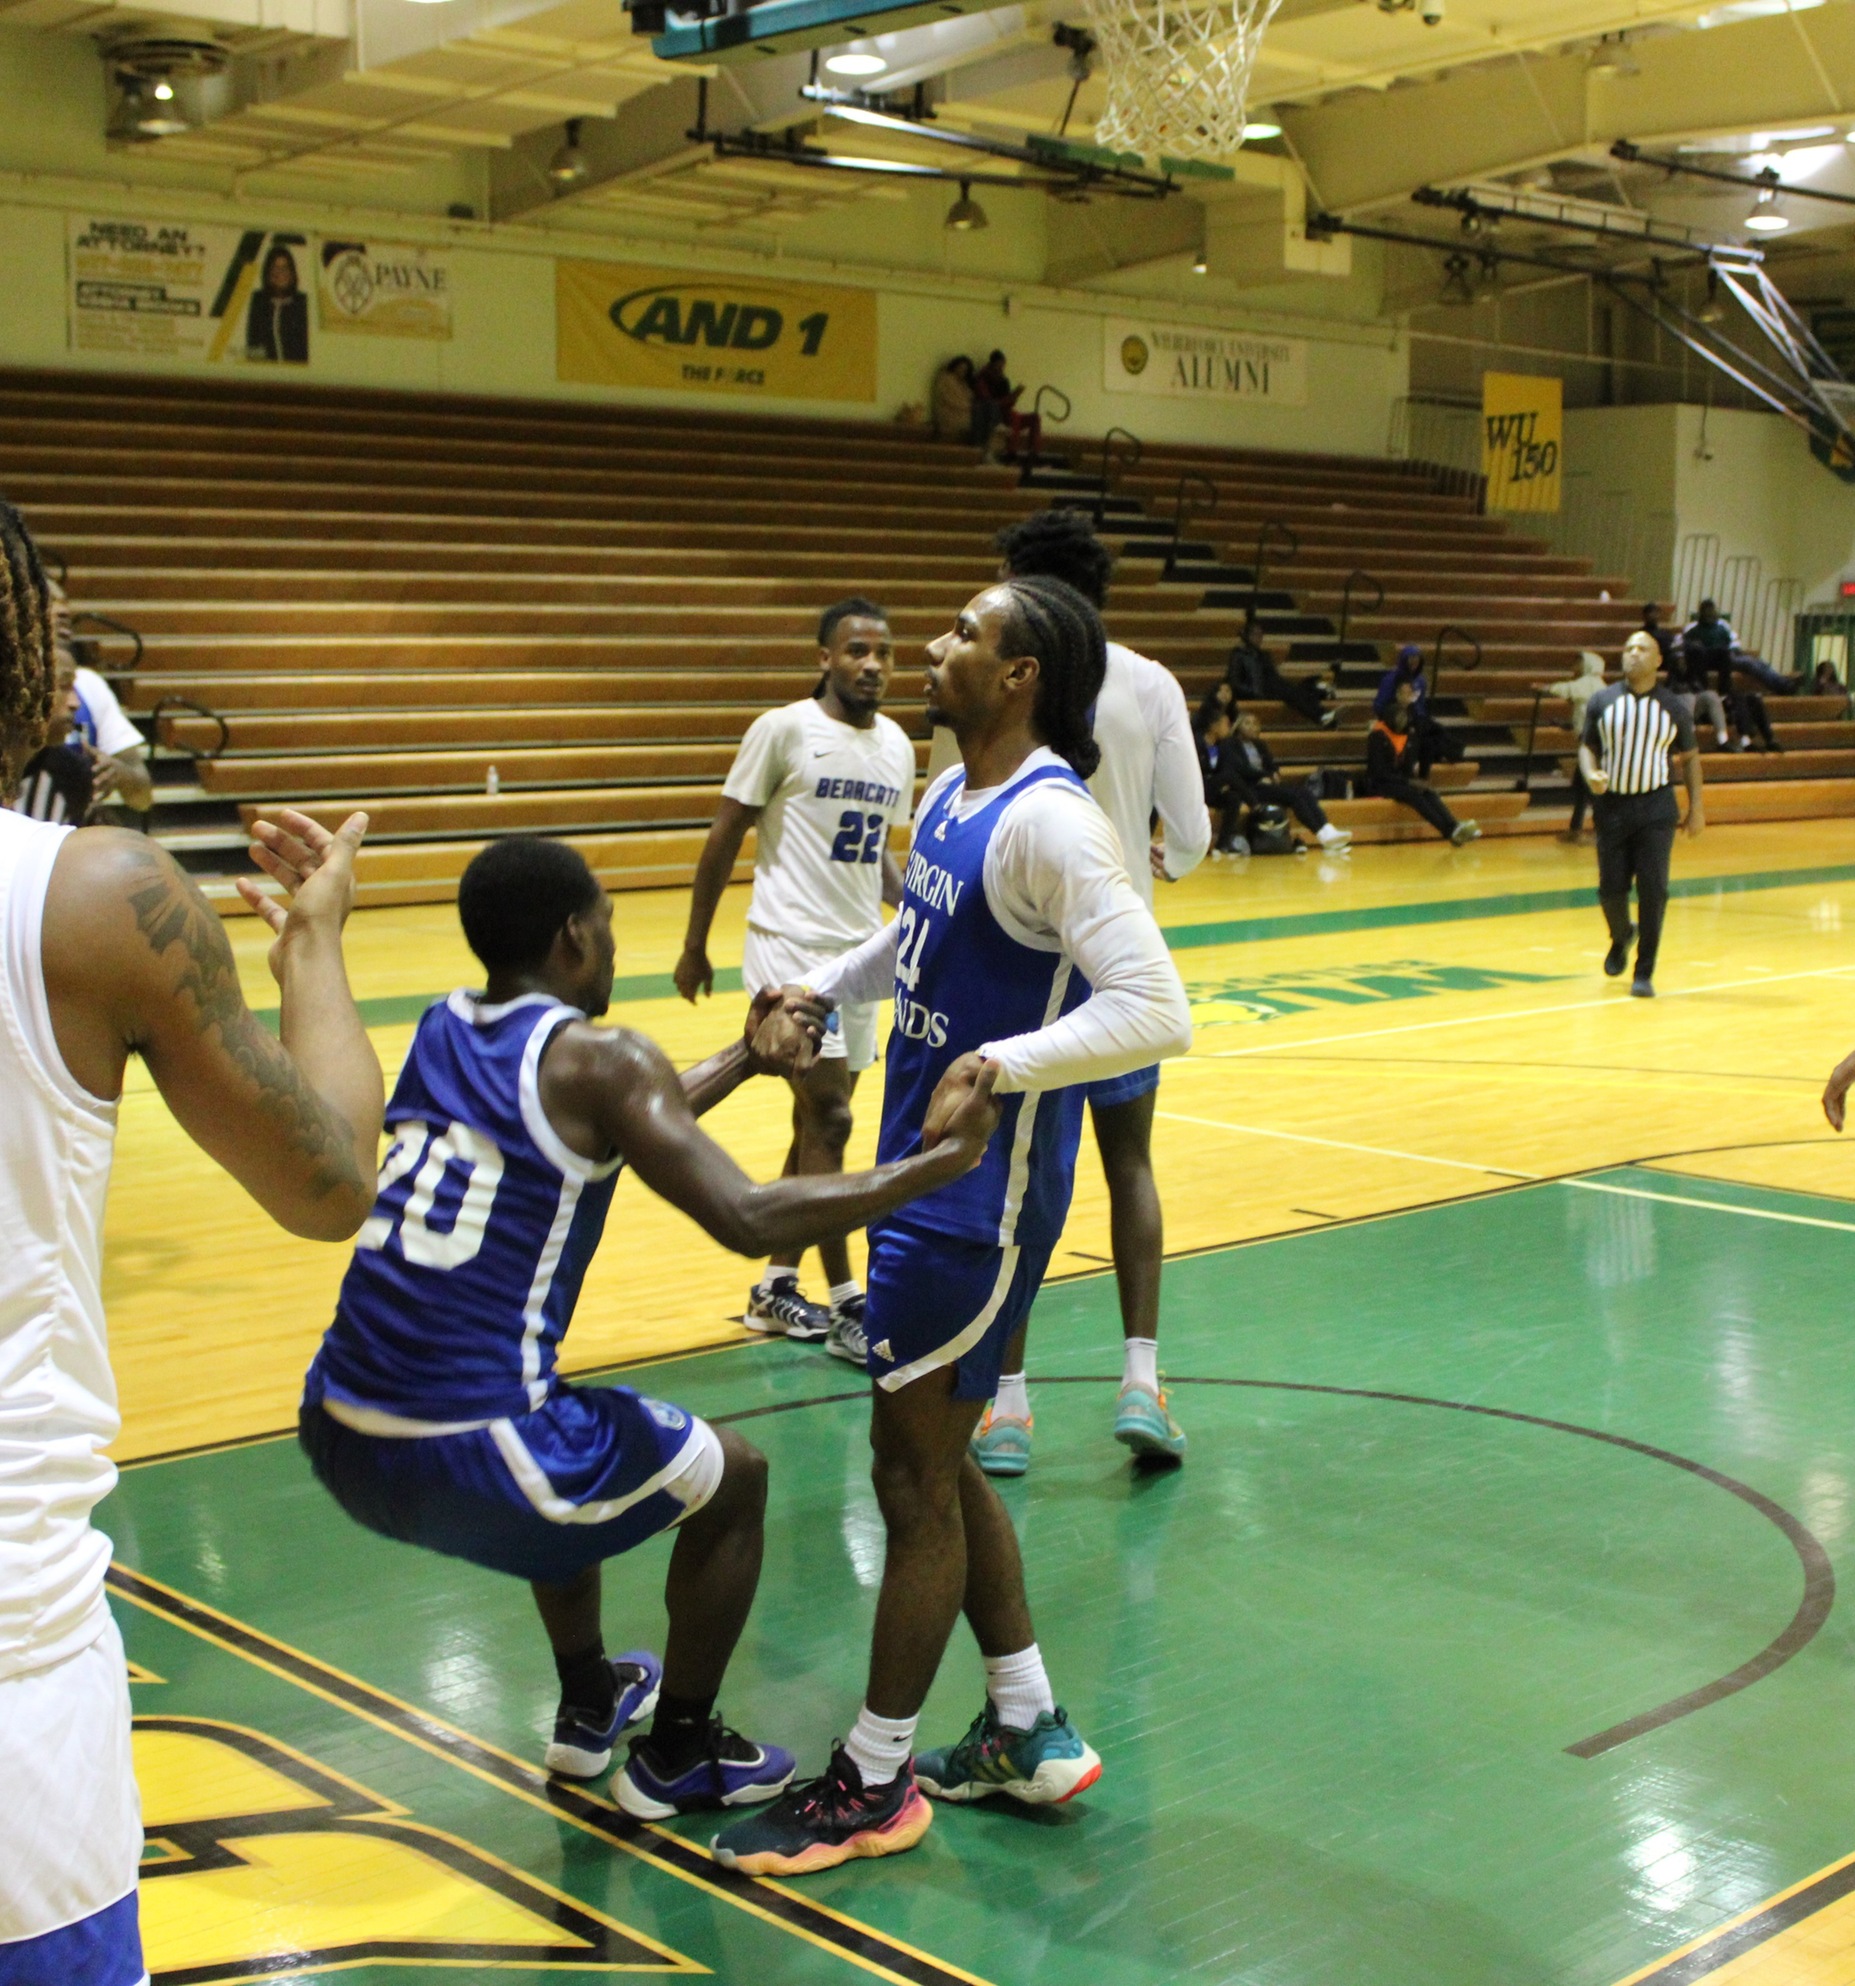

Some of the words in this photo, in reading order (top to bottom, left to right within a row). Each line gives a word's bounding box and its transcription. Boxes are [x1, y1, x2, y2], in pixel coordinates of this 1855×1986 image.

[158, 227, 187, 242] AN
[375, 262, 447, 290] PAYNE
[632, 296, 783, 351] AND
[799, 312, 830, 357] 1
[682, 363, 711, 382] THE
[1170, 354, 1270, 395] ALUMNI
[1486, 411, 1538, 449] WU
[1510, 440, 1558, 481] 150
[830, 810, 884, 864] 22
[355, 1119, 505, 1272] 20
